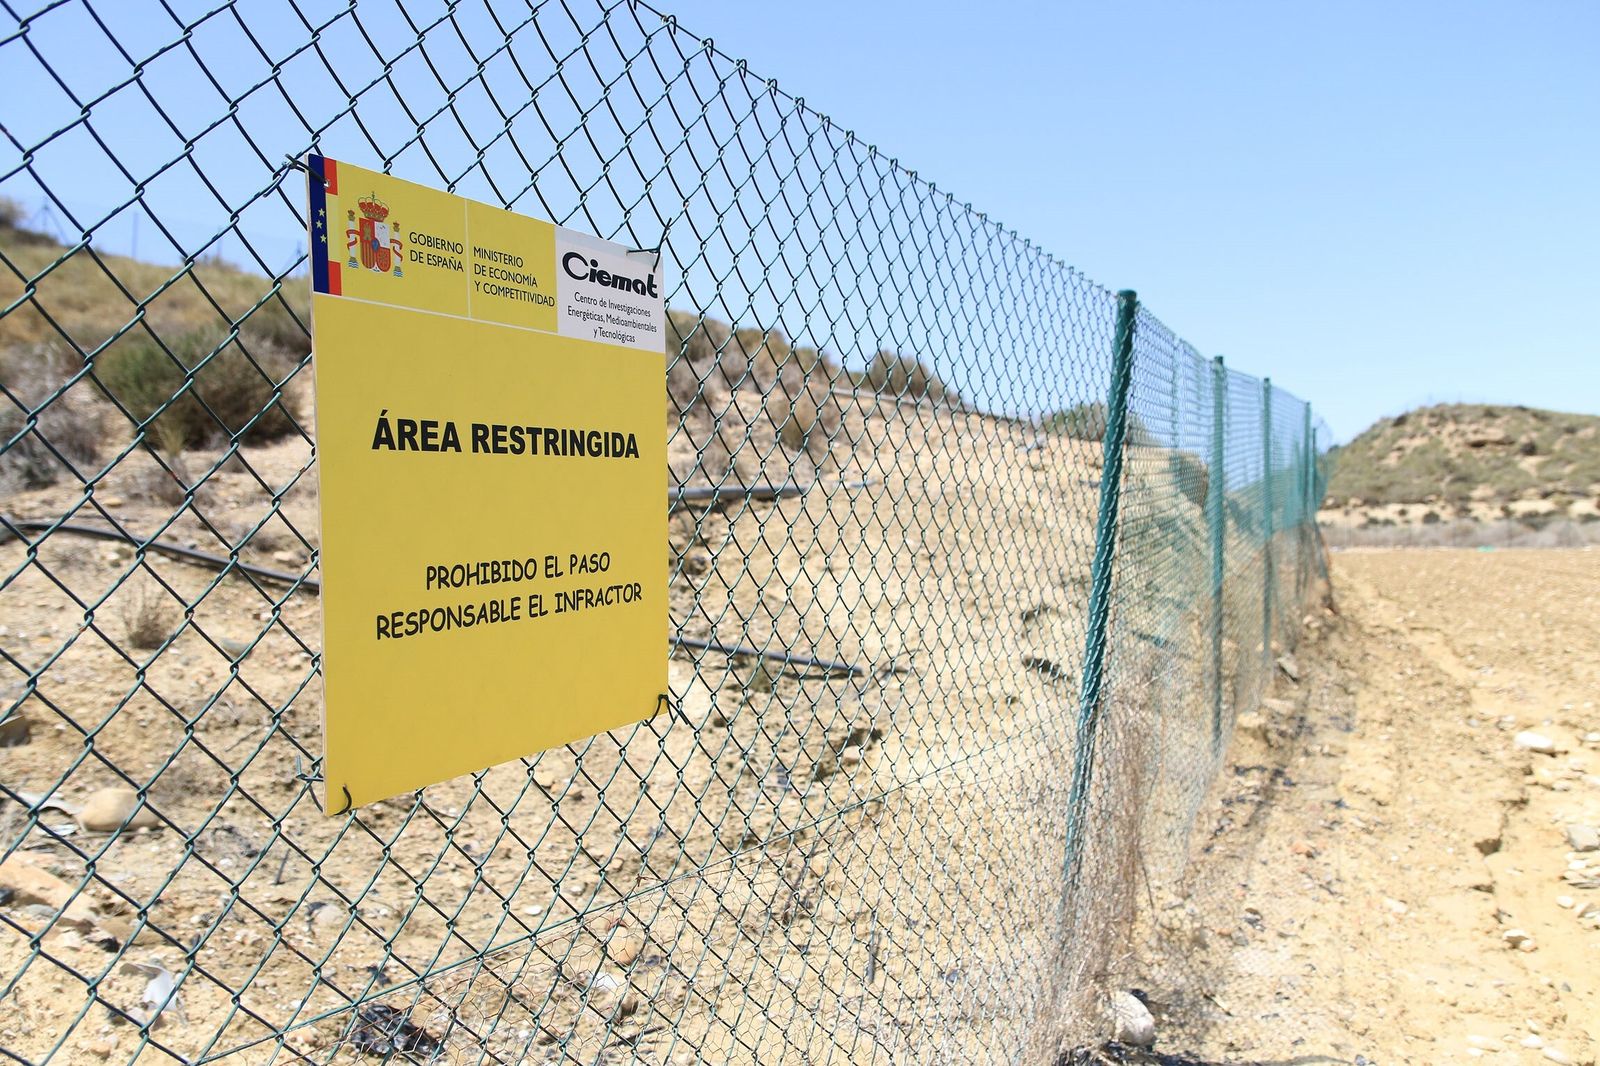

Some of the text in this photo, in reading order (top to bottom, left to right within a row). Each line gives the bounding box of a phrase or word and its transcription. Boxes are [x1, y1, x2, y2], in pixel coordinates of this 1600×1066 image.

[409, 231, 464, 255] GOBIERNO
[410, 249, 464, 273] DE ESPAÑA
[473, 246, 524, 268] MINISTERIO
[474, 263, 538, 288] DE ECONOMÍA
[562, 251, 658, 299] Ciemat
[474, 280, 555, 307] Y COMPETITIVIDAD
[574, 291, 651, 317] Centro de Investigaciones
[567, 305, 657, 332] Energéticas, Medioambientales
[593, 326, 636, 343] y Tecnológicas
[371, 408, 640, 459] ÁREA RESTRINGIDA
[426, 551, 611, 591] PROHIBIDO EL PASO
[376, 582, 642, 640] RESPONSABLE EL INFRACTOR
